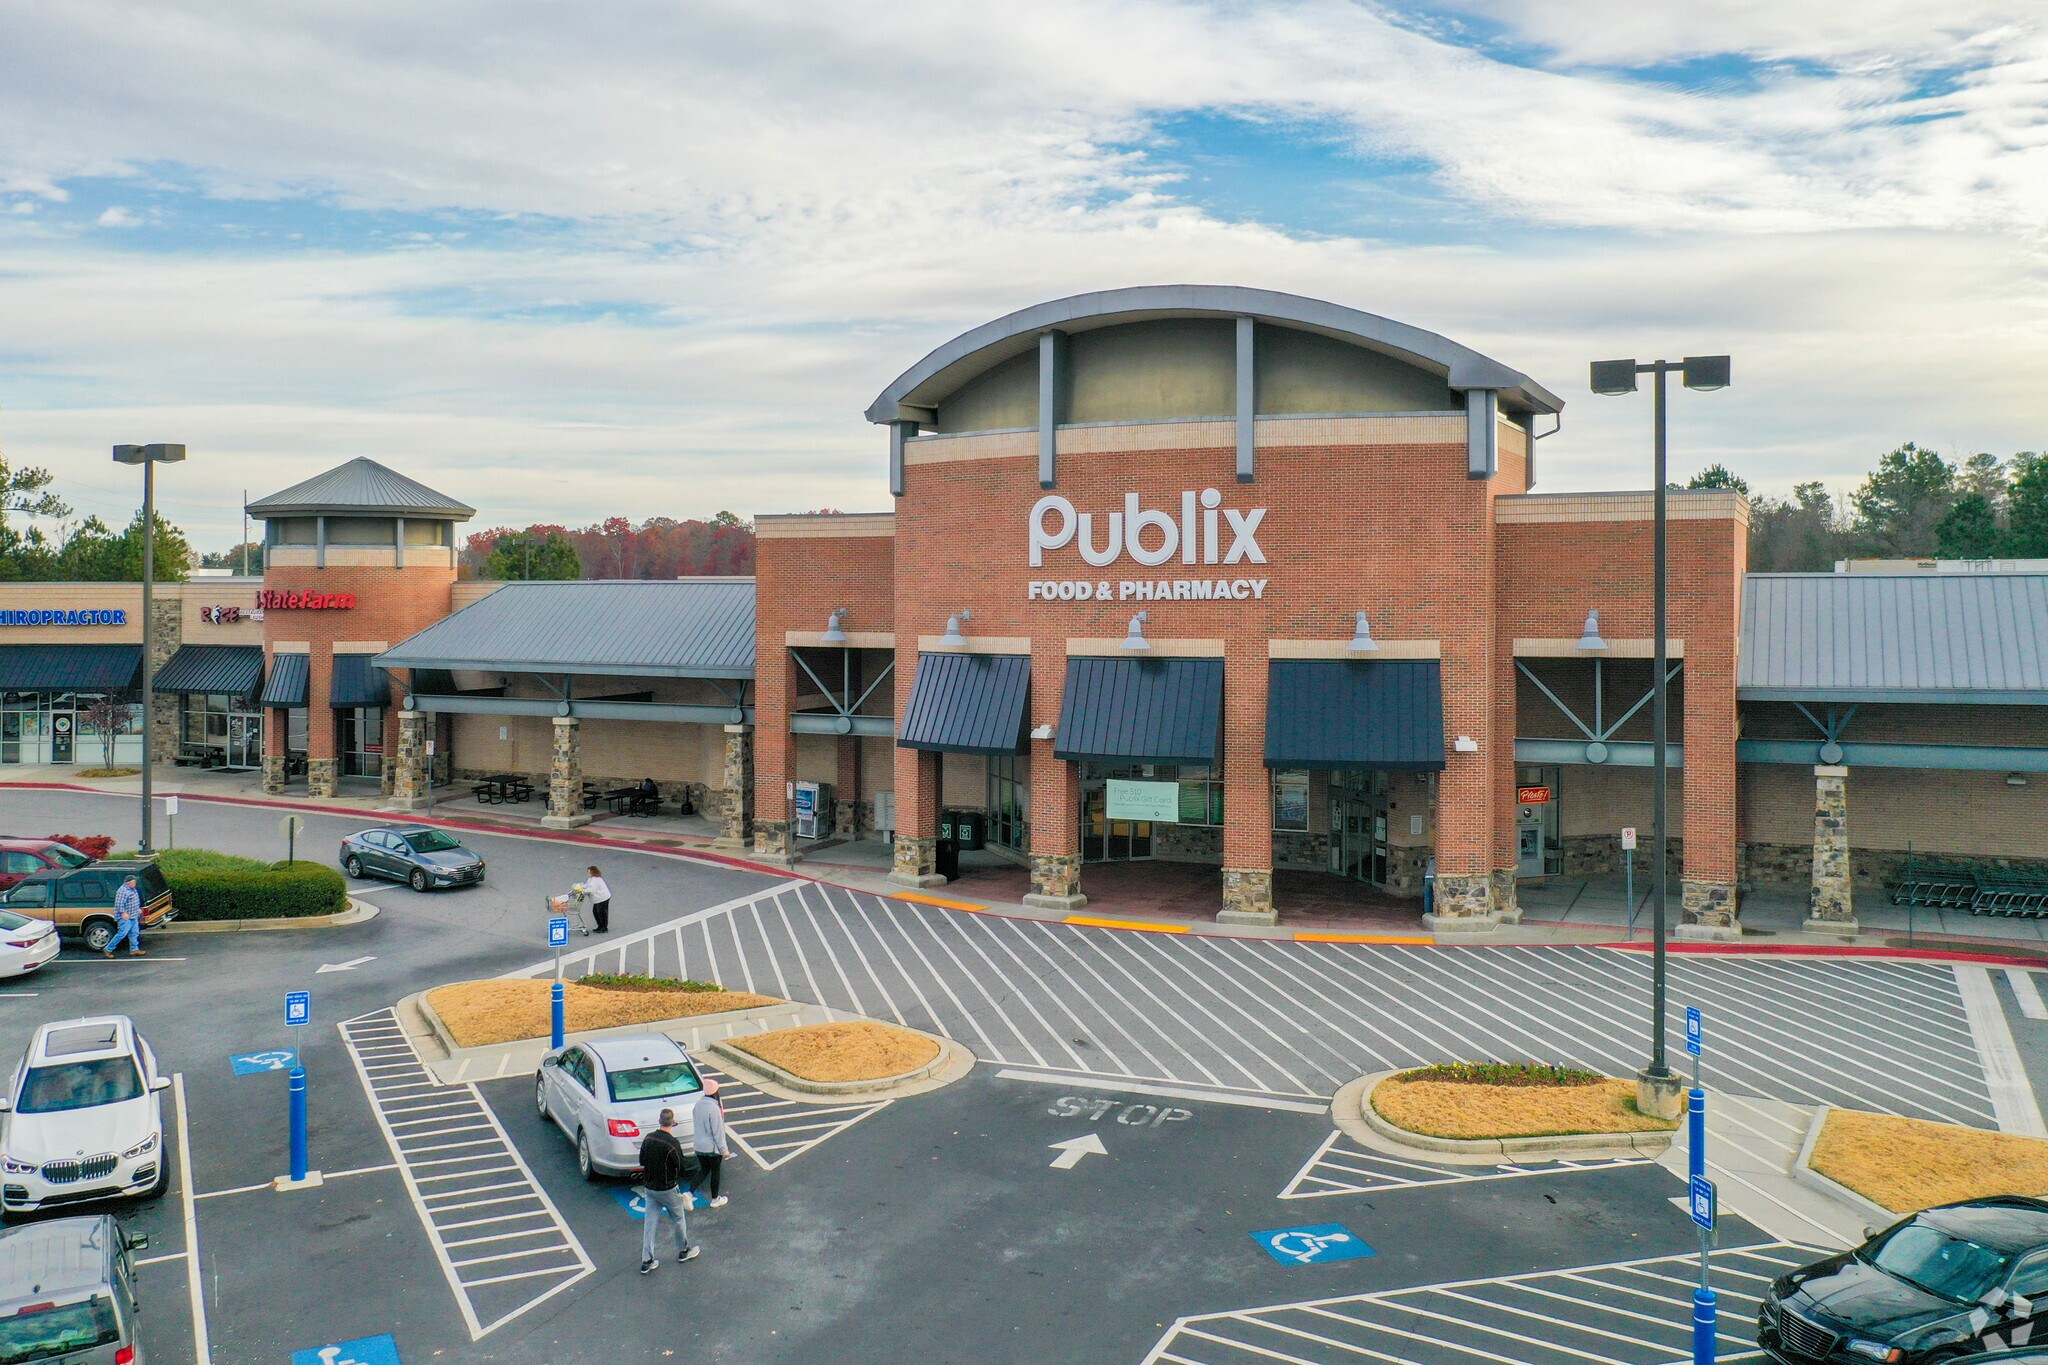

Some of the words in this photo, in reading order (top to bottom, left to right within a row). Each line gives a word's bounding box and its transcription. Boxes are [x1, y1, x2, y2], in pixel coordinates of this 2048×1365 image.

[1029, 488, 1267, 567] Publix
[1029, 581, 1093, 600] FOOD
[1096, 581, 1114, 600] &
[1120, 579, 1268, 600] PHARMACY
[1114, 787, 1129, 795] Free
[1154, 796, 1172, 804] Card
[1048, 1096, 1194, 1128] STOP
